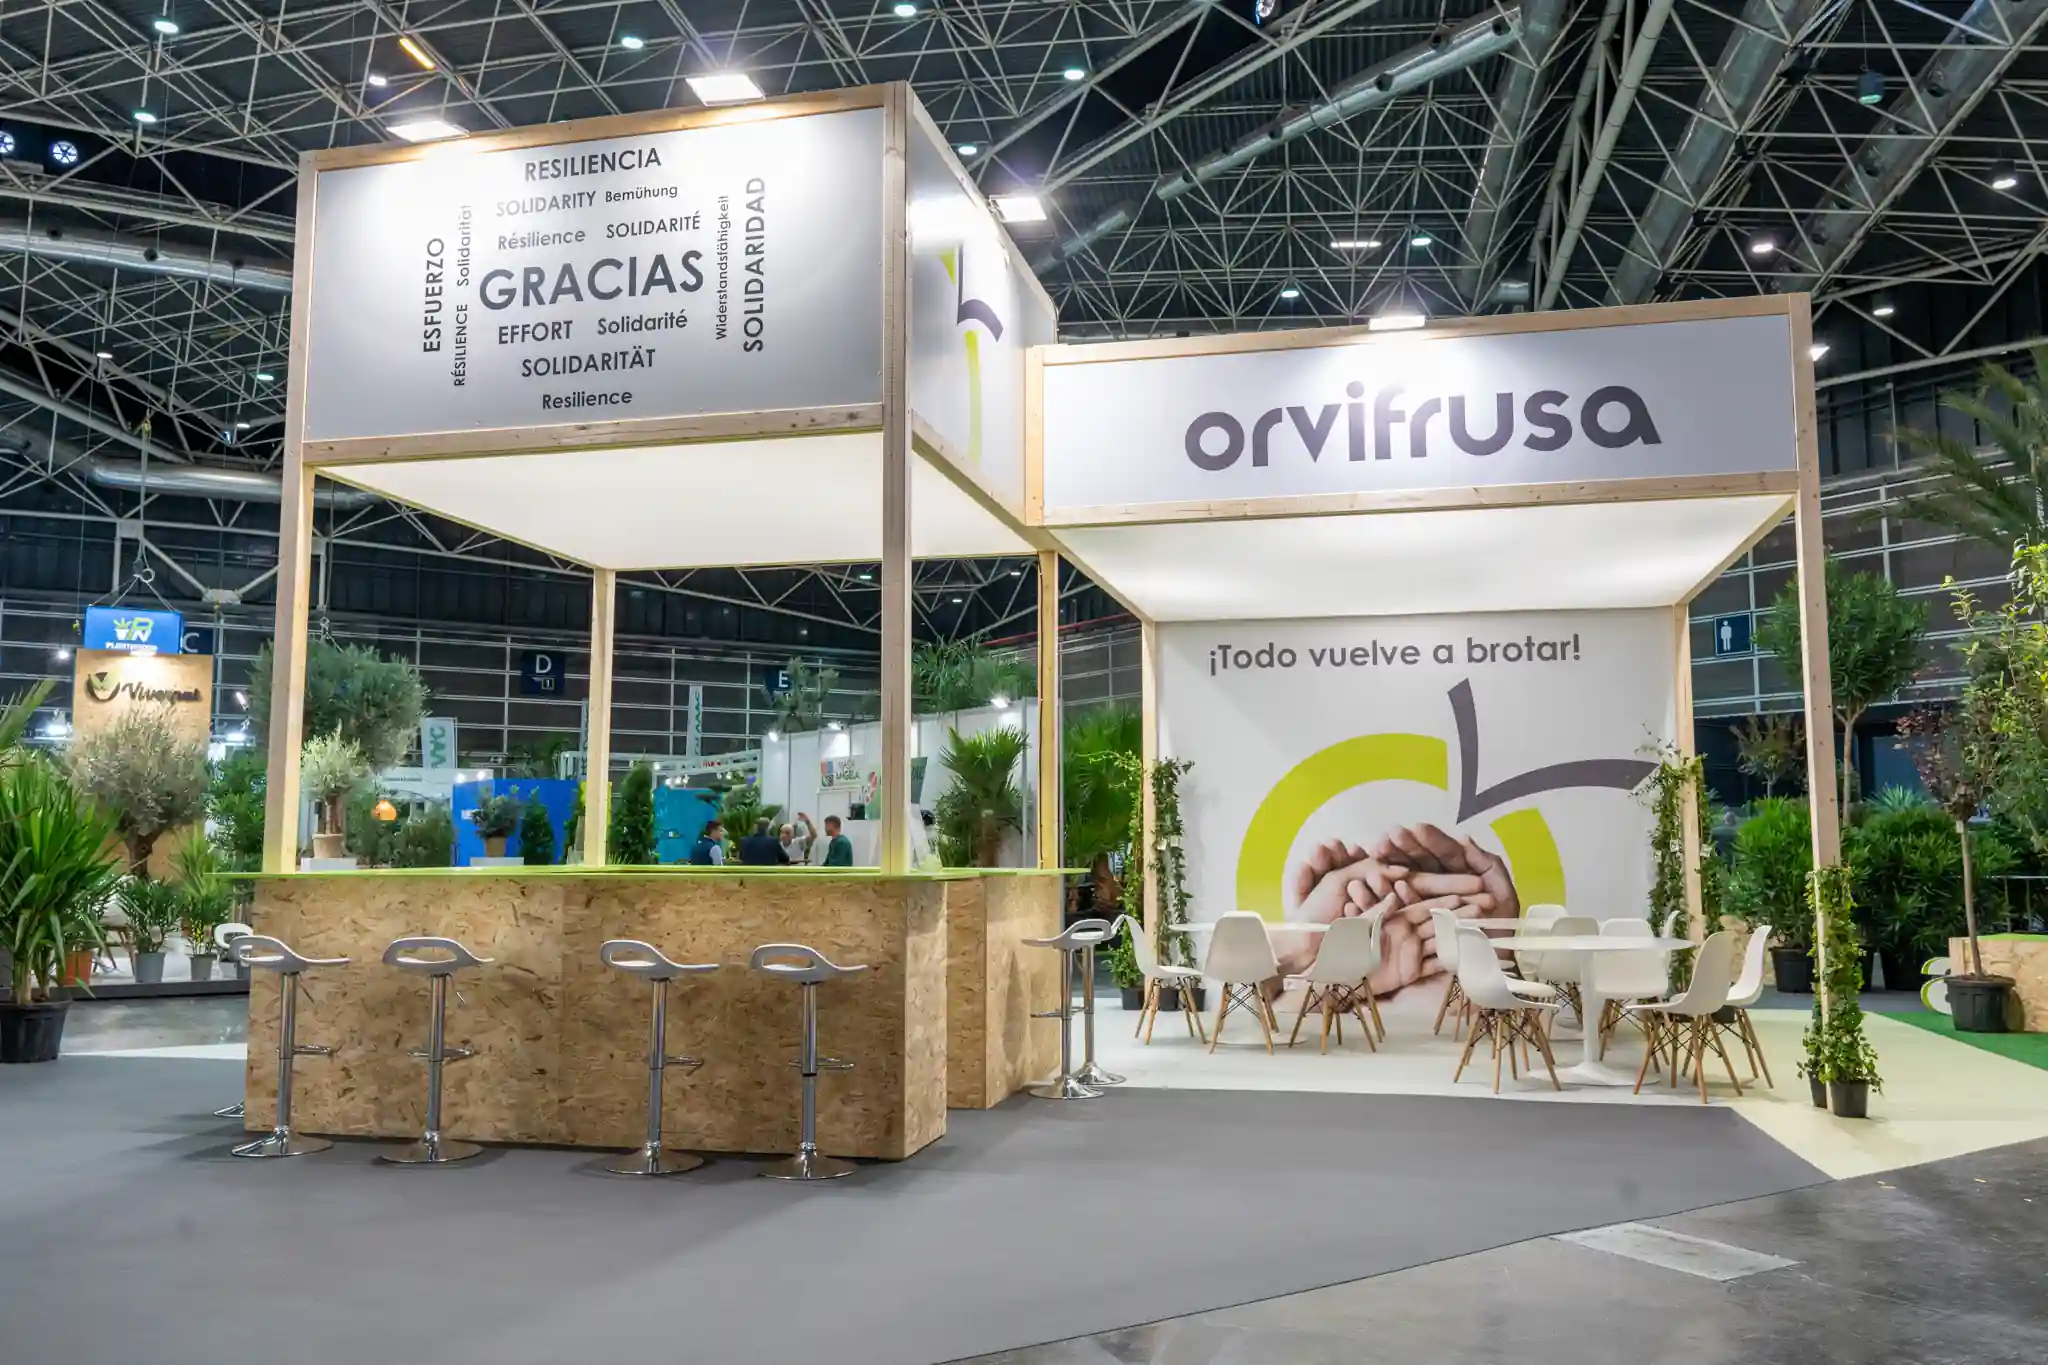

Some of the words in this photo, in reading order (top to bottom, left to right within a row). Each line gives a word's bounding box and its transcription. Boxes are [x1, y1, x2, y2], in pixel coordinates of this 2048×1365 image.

[524, 147, 662, 182] RESILIENCIA
[495, 190, 596, 217] SOLIDARITY
[605, 184, 678, 203] Bemühung
[498, 228, 586, 251] Résilience
[606, 211, 701, 239] SOLIDARITÉ
[479, 250, 704, 311] GRACIAS
[715, 195, 731, 340] Widerstandsfähigkeit
[743, 177, 765, 353] SOLIDARIDAD
[423, 237, 445, 352] ESFUERZO
[453, 303, 468, 387] RÉSILIENCE
[498, 320, 573, 345] EFFORT
[597, 308, 688, 336] Solidarité
[521, 346, 656, 378] SOLIDARITÄT
[542, 390, 633, 410] Resilience
[1184, 380, 1663, 472] orvifrusa
[183, 632, 200, 653] C
[1209, 642, 1298, 677] ¡Todo
[1308, 639, 1421, 669] vuelve
[1432, 642, 1454, 665] a
[1466, 633, 1582, 664] brotar!
[536, 654, 552, 673] D
[779, 670, 790, 687] E
